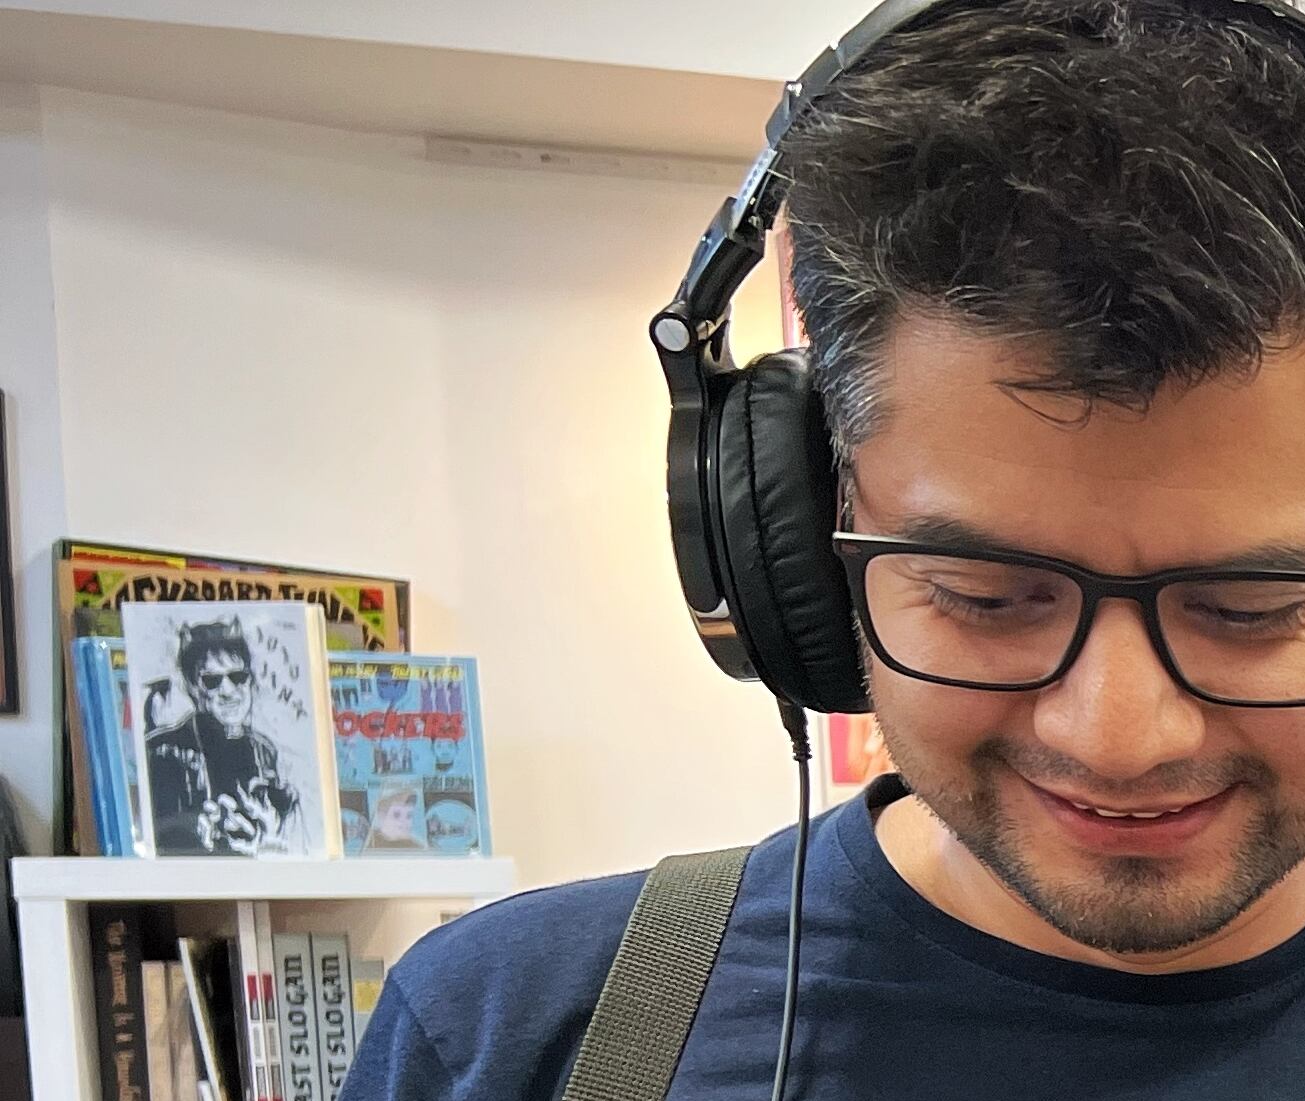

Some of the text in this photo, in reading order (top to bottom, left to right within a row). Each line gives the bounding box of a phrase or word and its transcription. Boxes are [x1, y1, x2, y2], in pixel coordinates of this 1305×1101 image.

[334, 710, 467, 740] OCKERS
[284, 954, 310, 1060] SLOGAN
[321, 954, 346, 1057] SLOGAN
